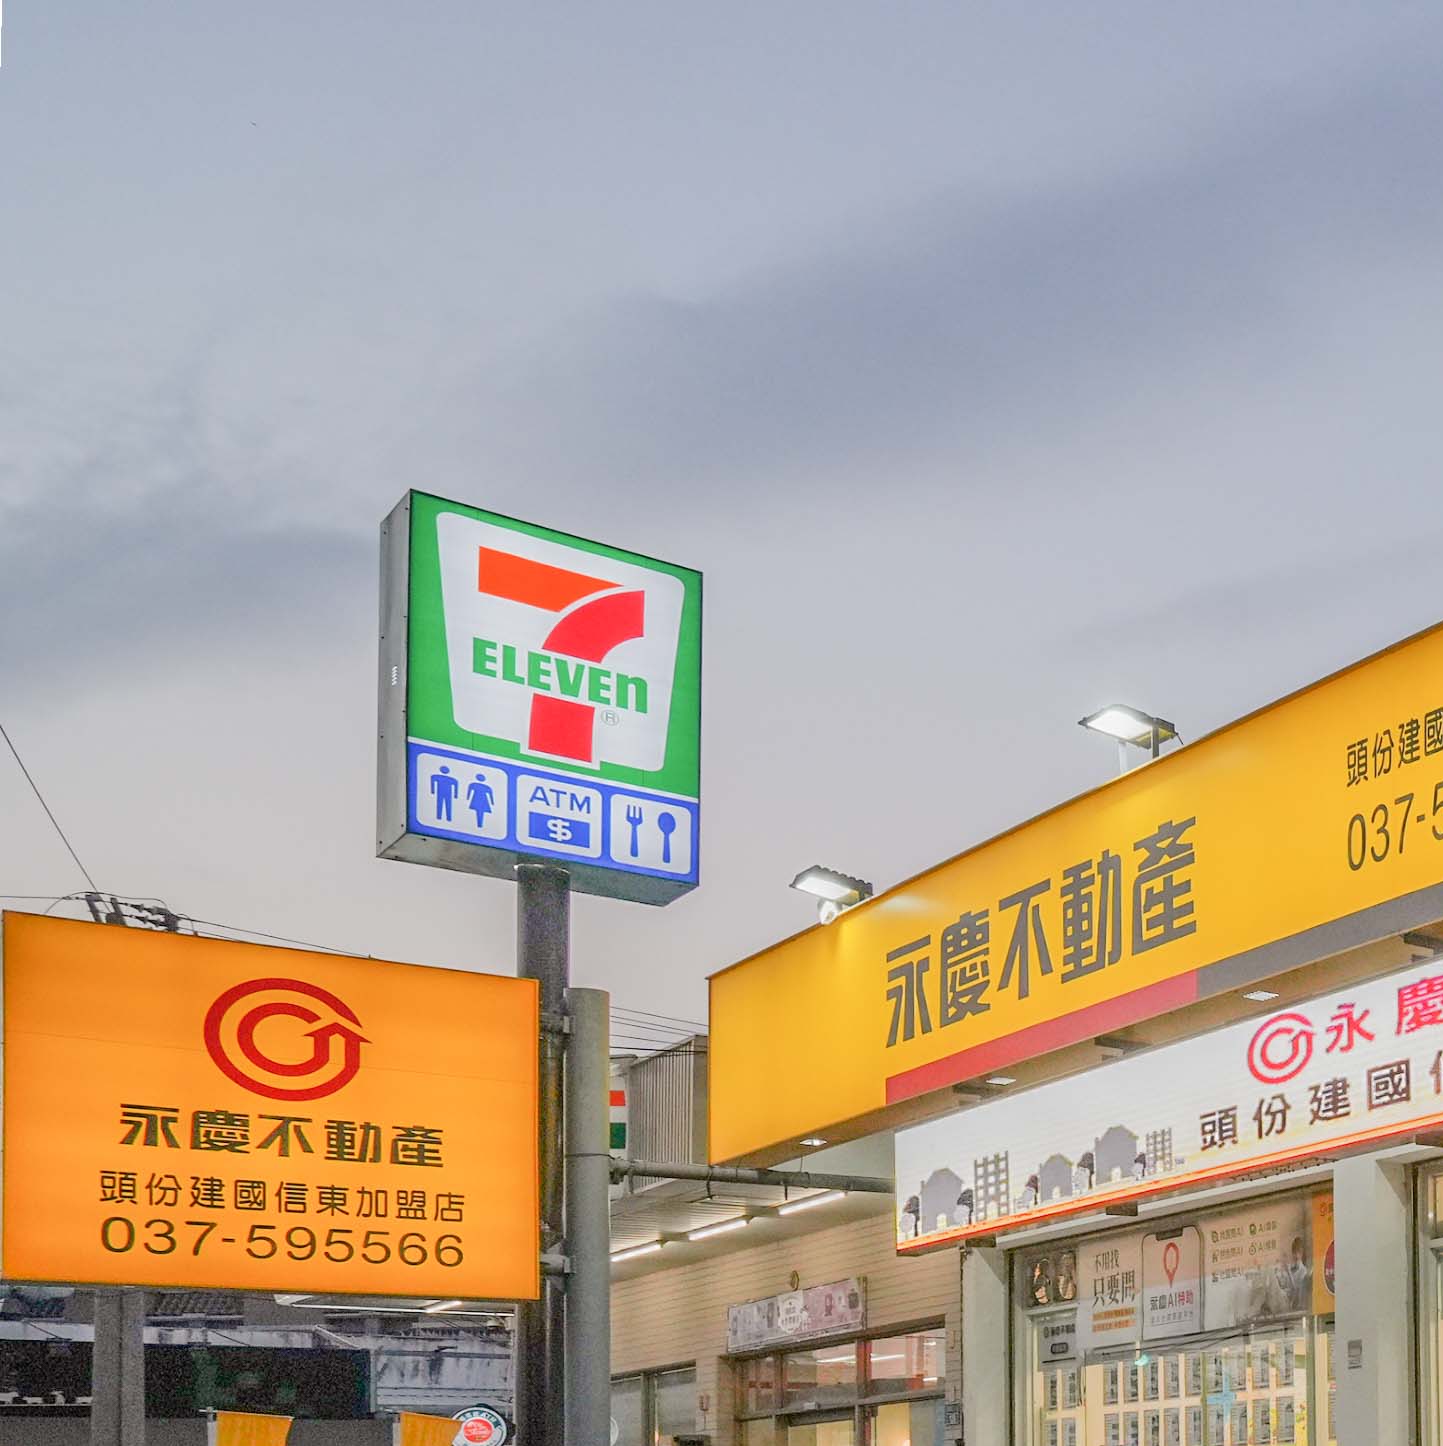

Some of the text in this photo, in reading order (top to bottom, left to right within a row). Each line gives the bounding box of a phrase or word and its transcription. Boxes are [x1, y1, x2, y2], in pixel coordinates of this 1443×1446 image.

[478, 546, 644, 763] 7
[529, 786, 592, 814] ATM
[886, 816, 1196, 1047] 永慶不動產
[118, 1104, 445, 1167] 永慶不動產
[99, 1171, 466, 1224] 頭份建國信東加盟店
[100, 1216, 465, 1268] 037-595566
